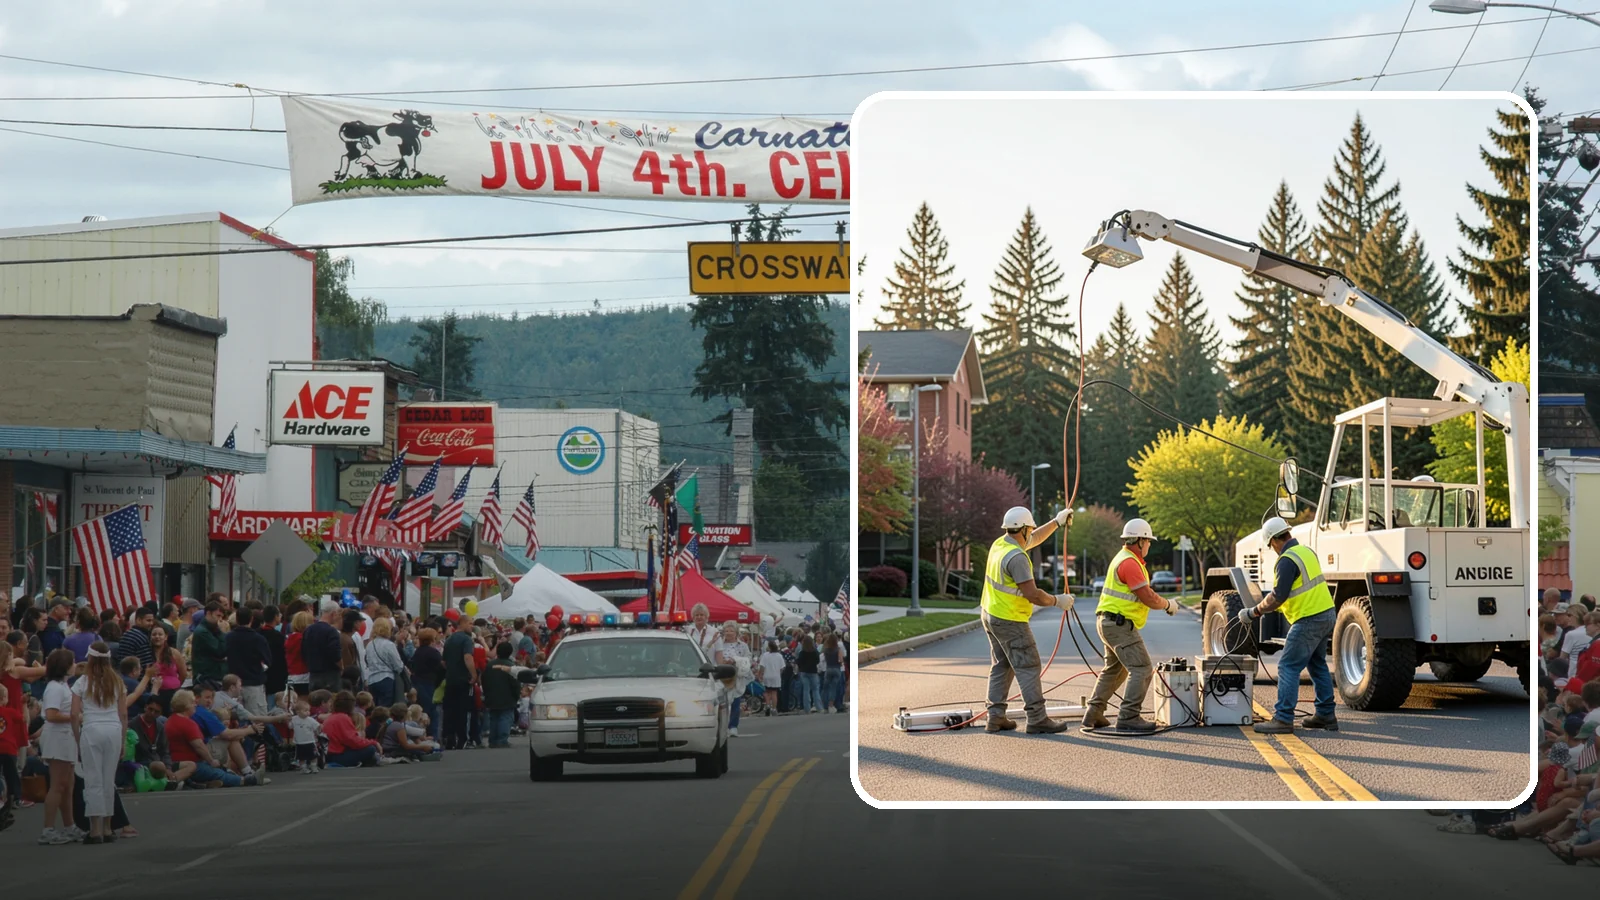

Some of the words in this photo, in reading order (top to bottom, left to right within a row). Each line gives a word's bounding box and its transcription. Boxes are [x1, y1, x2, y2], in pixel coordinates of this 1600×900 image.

[694, 121, 850, 150] Carnat
[481, 140, 605, 193] JULY
[632, 150, 747, 198] 4th.
[696, 253, 850, 280] CROSSWA
[283, 380, 373, 420] ACE
[406, 409, 452, 423] CEDAR
[283, 421, 371, 437] Hardware
[416, 427, 477, 447] Coca-Cola
[353, 466, 384, 482] Simpl
[83, 485, 94, 495] St.
[96, 485, 124, 495] Vincent
[126, 485, 136, 495] de
[138, 485, 155, 496] Paul
[688, 526, 742, 536] CRNATION
[699, 535, 730, 544] GLASS
